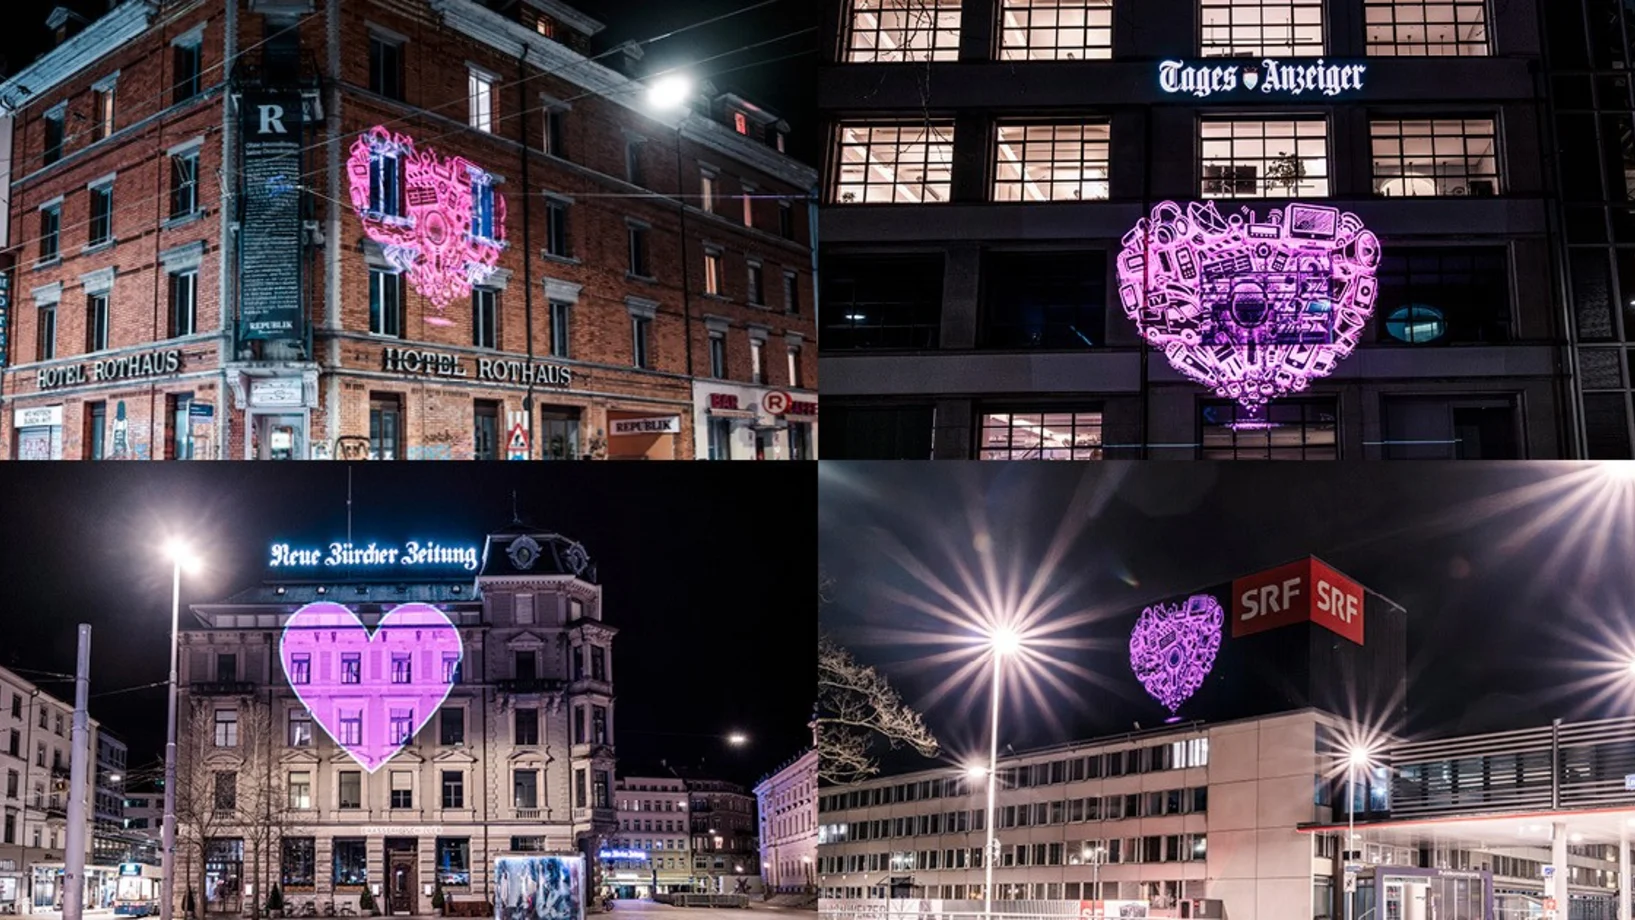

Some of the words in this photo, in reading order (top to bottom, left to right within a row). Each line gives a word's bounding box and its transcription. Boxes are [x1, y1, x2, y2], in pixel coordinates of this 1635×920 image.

[1159, 60, 1239, 97] Tages
[1261, 58, 1367, 96] Anzeiger
[257, 104, 288, 134] R
[36, 364, 87, 389] HOTEL
[94, 350, 180, 382] ROTHAUS
[386, 348, 467, 377] HOTEL
[478, 357, 572, 386] ROTHAUS
[710, 393, 739, 410] BAR
[768, 395, 783, 410] R
[616, 420, 672, 433] REPUBLIK
[269, 542, 321, 567] Neue
[324, 541, 399, 566] Zürcher
[400, 541, 478, 570] Zeitung
[1240, 577, 1301, 621] SRF
[1317, 579, 1359, 624] SRF
